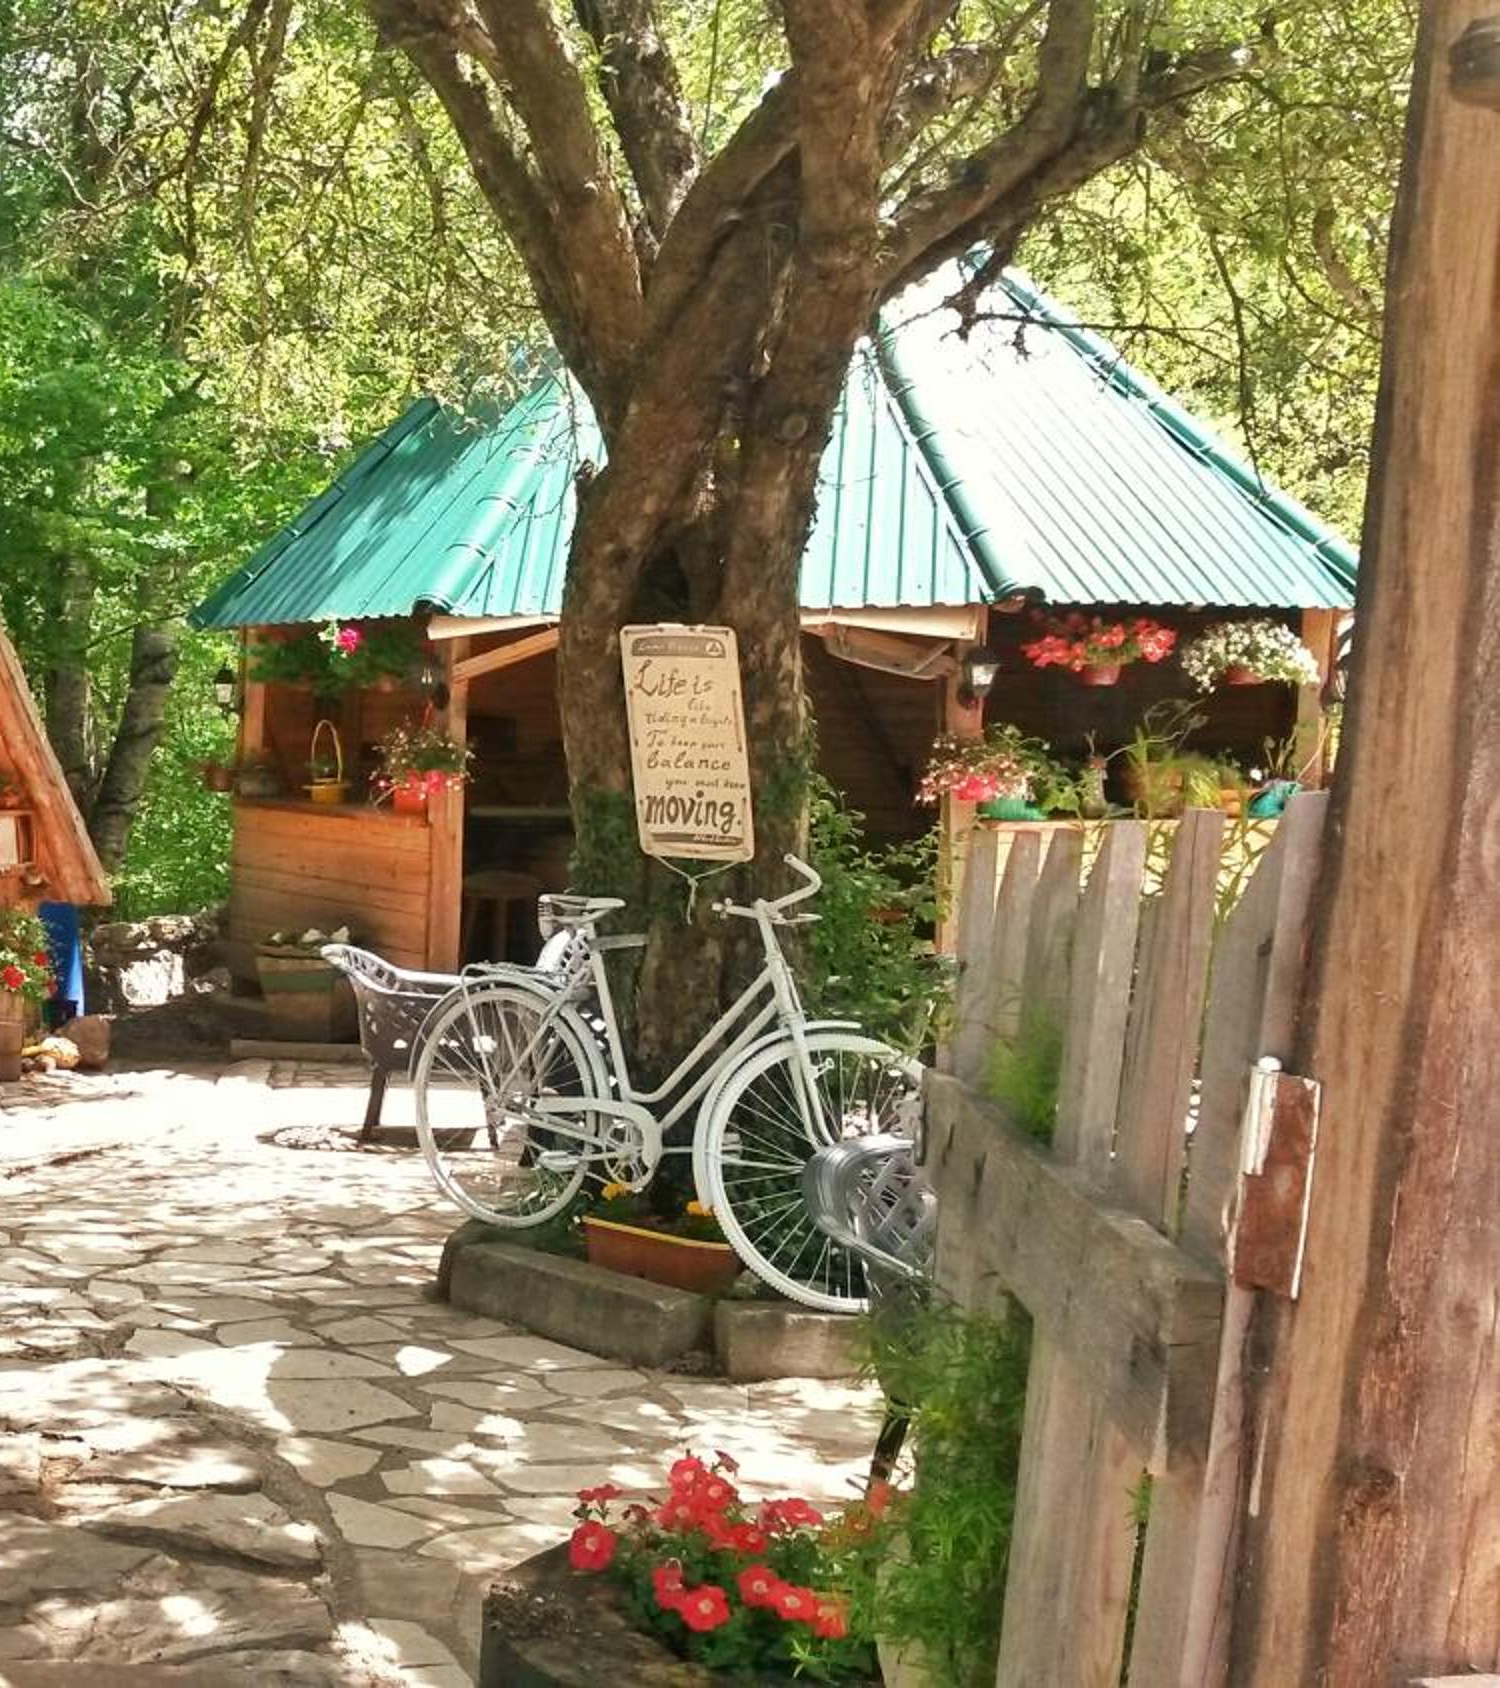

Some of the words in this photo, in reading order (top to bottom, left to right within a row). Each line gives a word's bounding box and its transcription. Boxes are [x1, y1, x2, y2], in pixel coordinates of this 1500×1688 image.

[633, 660, 687, 698] Life
[693, 674, 714, 695] is
[647, 749, 731, 770] balance
[644, 789, 741, 834] moving.
